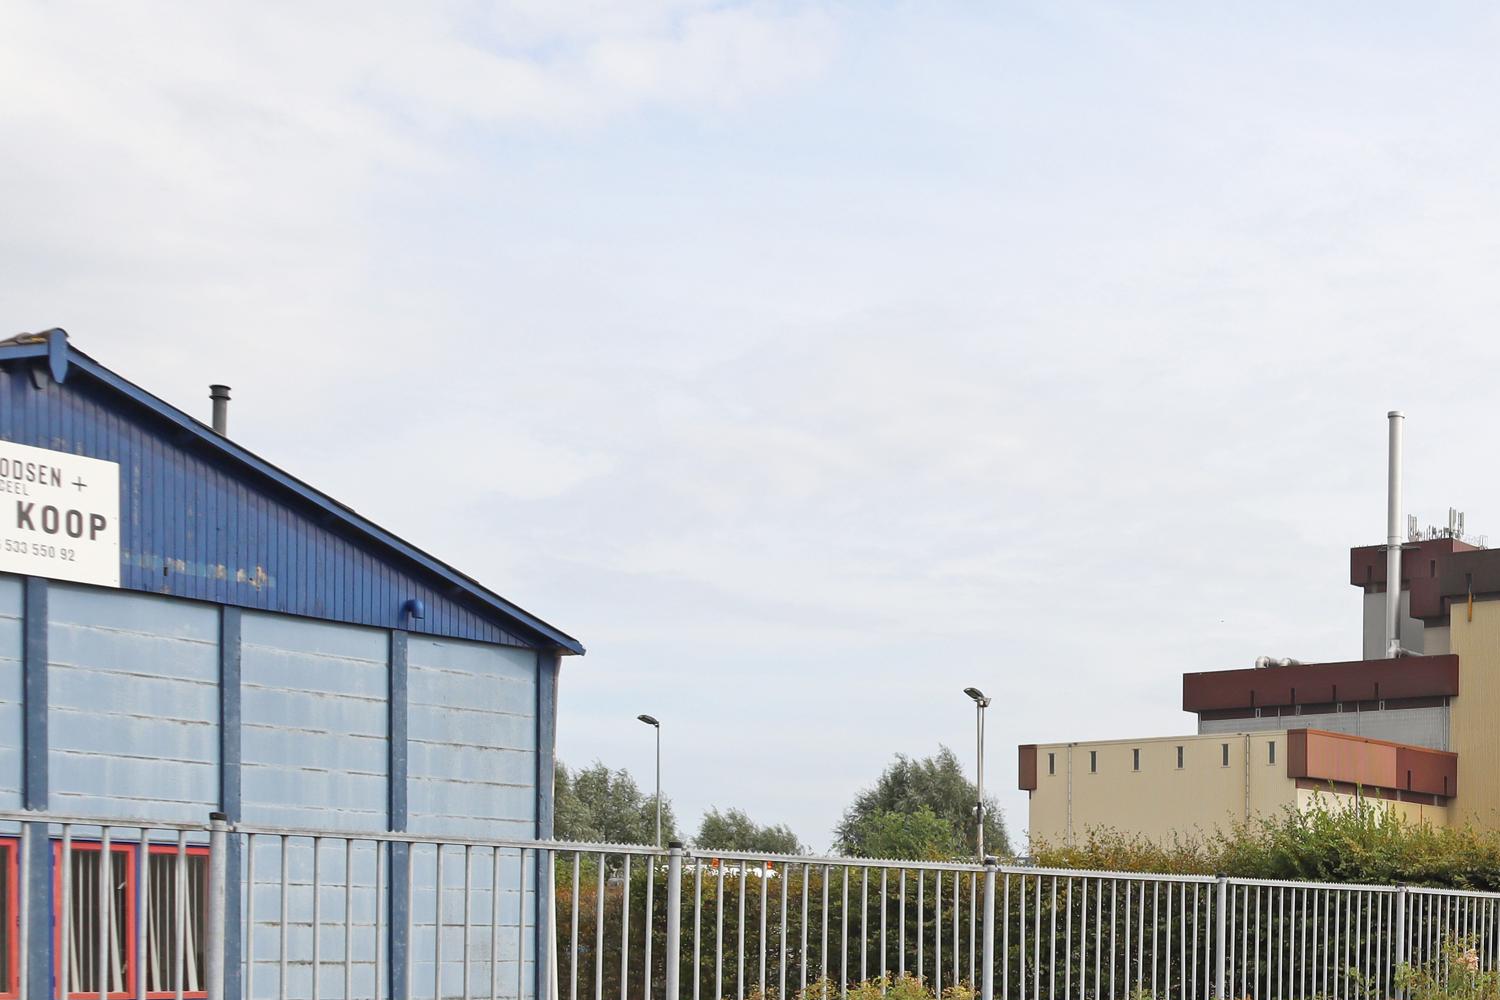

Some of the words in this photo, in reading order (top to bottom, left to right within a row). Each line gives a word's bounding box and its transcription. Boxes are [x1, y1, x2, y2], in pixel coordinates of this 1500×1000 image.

[16, 500, 107, 541] KOOP
[5, 538, 28, 555] 533
[32, 543, 56, 559] 550
[60, 548, 76, 562] 92
